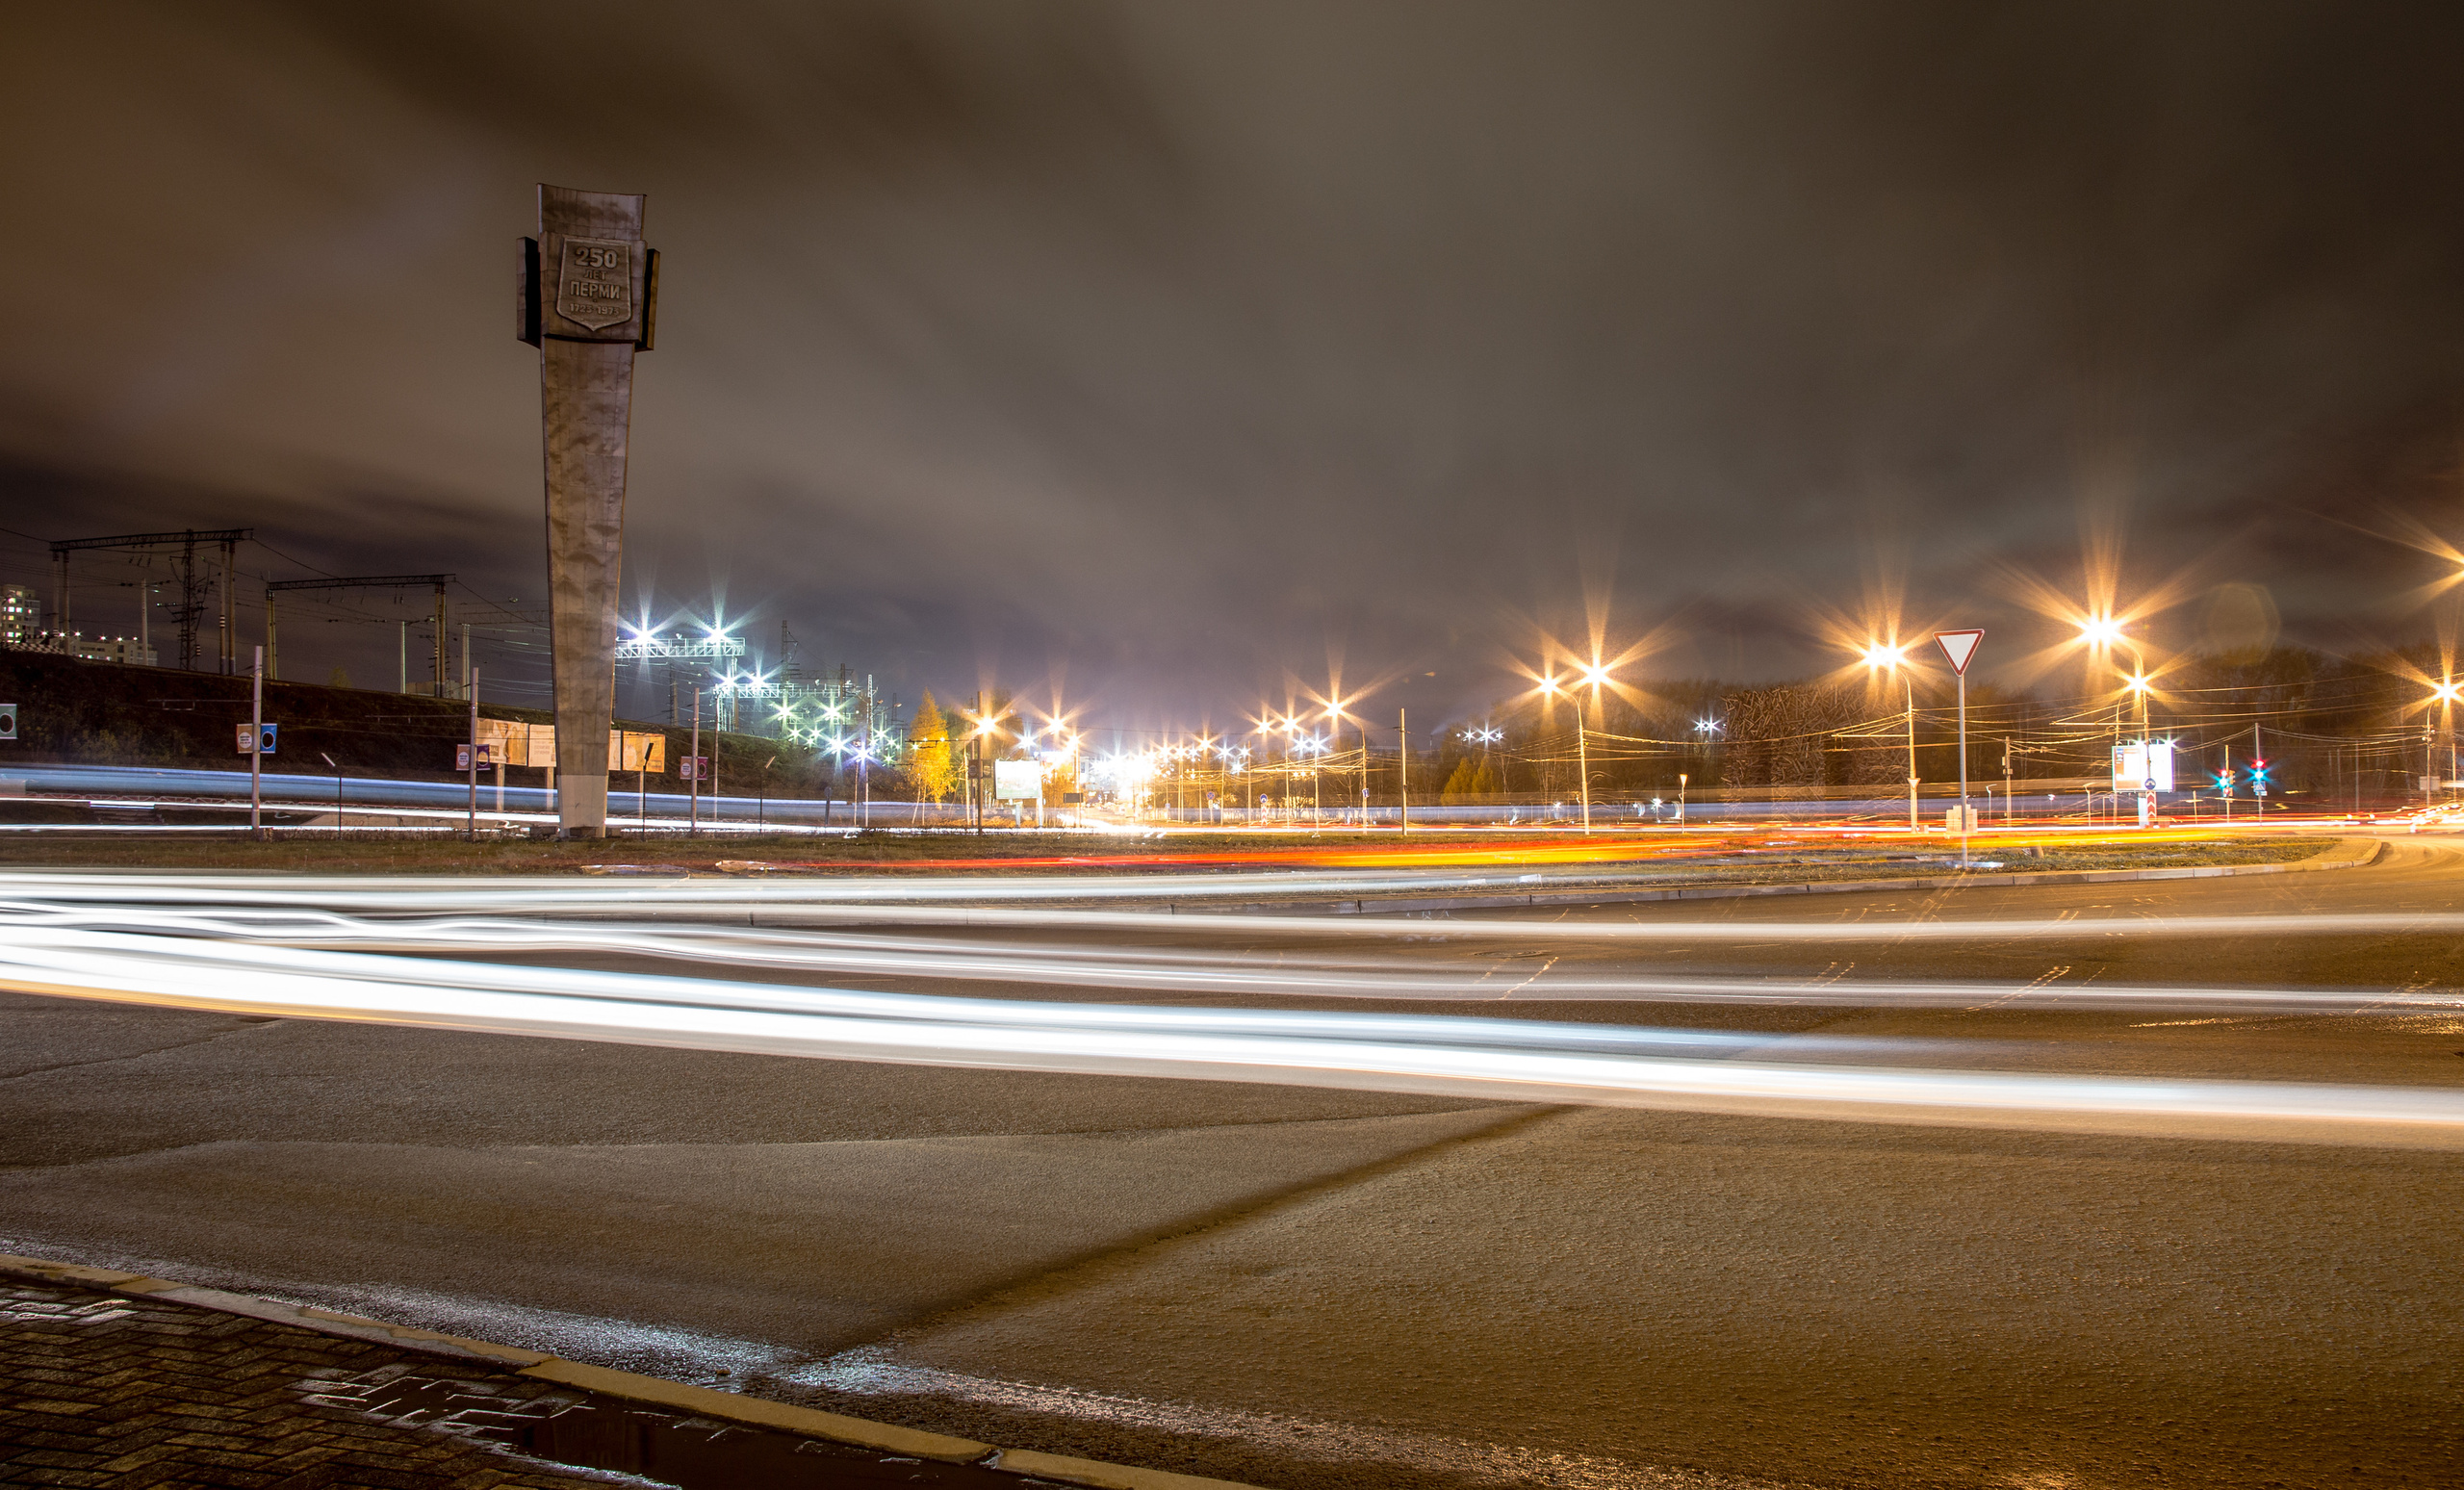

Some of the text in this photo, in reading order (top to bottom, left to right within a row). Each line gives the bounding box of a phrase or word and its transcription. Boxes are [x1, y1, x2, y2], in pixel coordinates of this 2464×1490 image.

[575, 246, 618, 269] 250
[584, 270, 606, 280] ЛЕТ
[570, 281, 620, 299] ПЕРМИ
